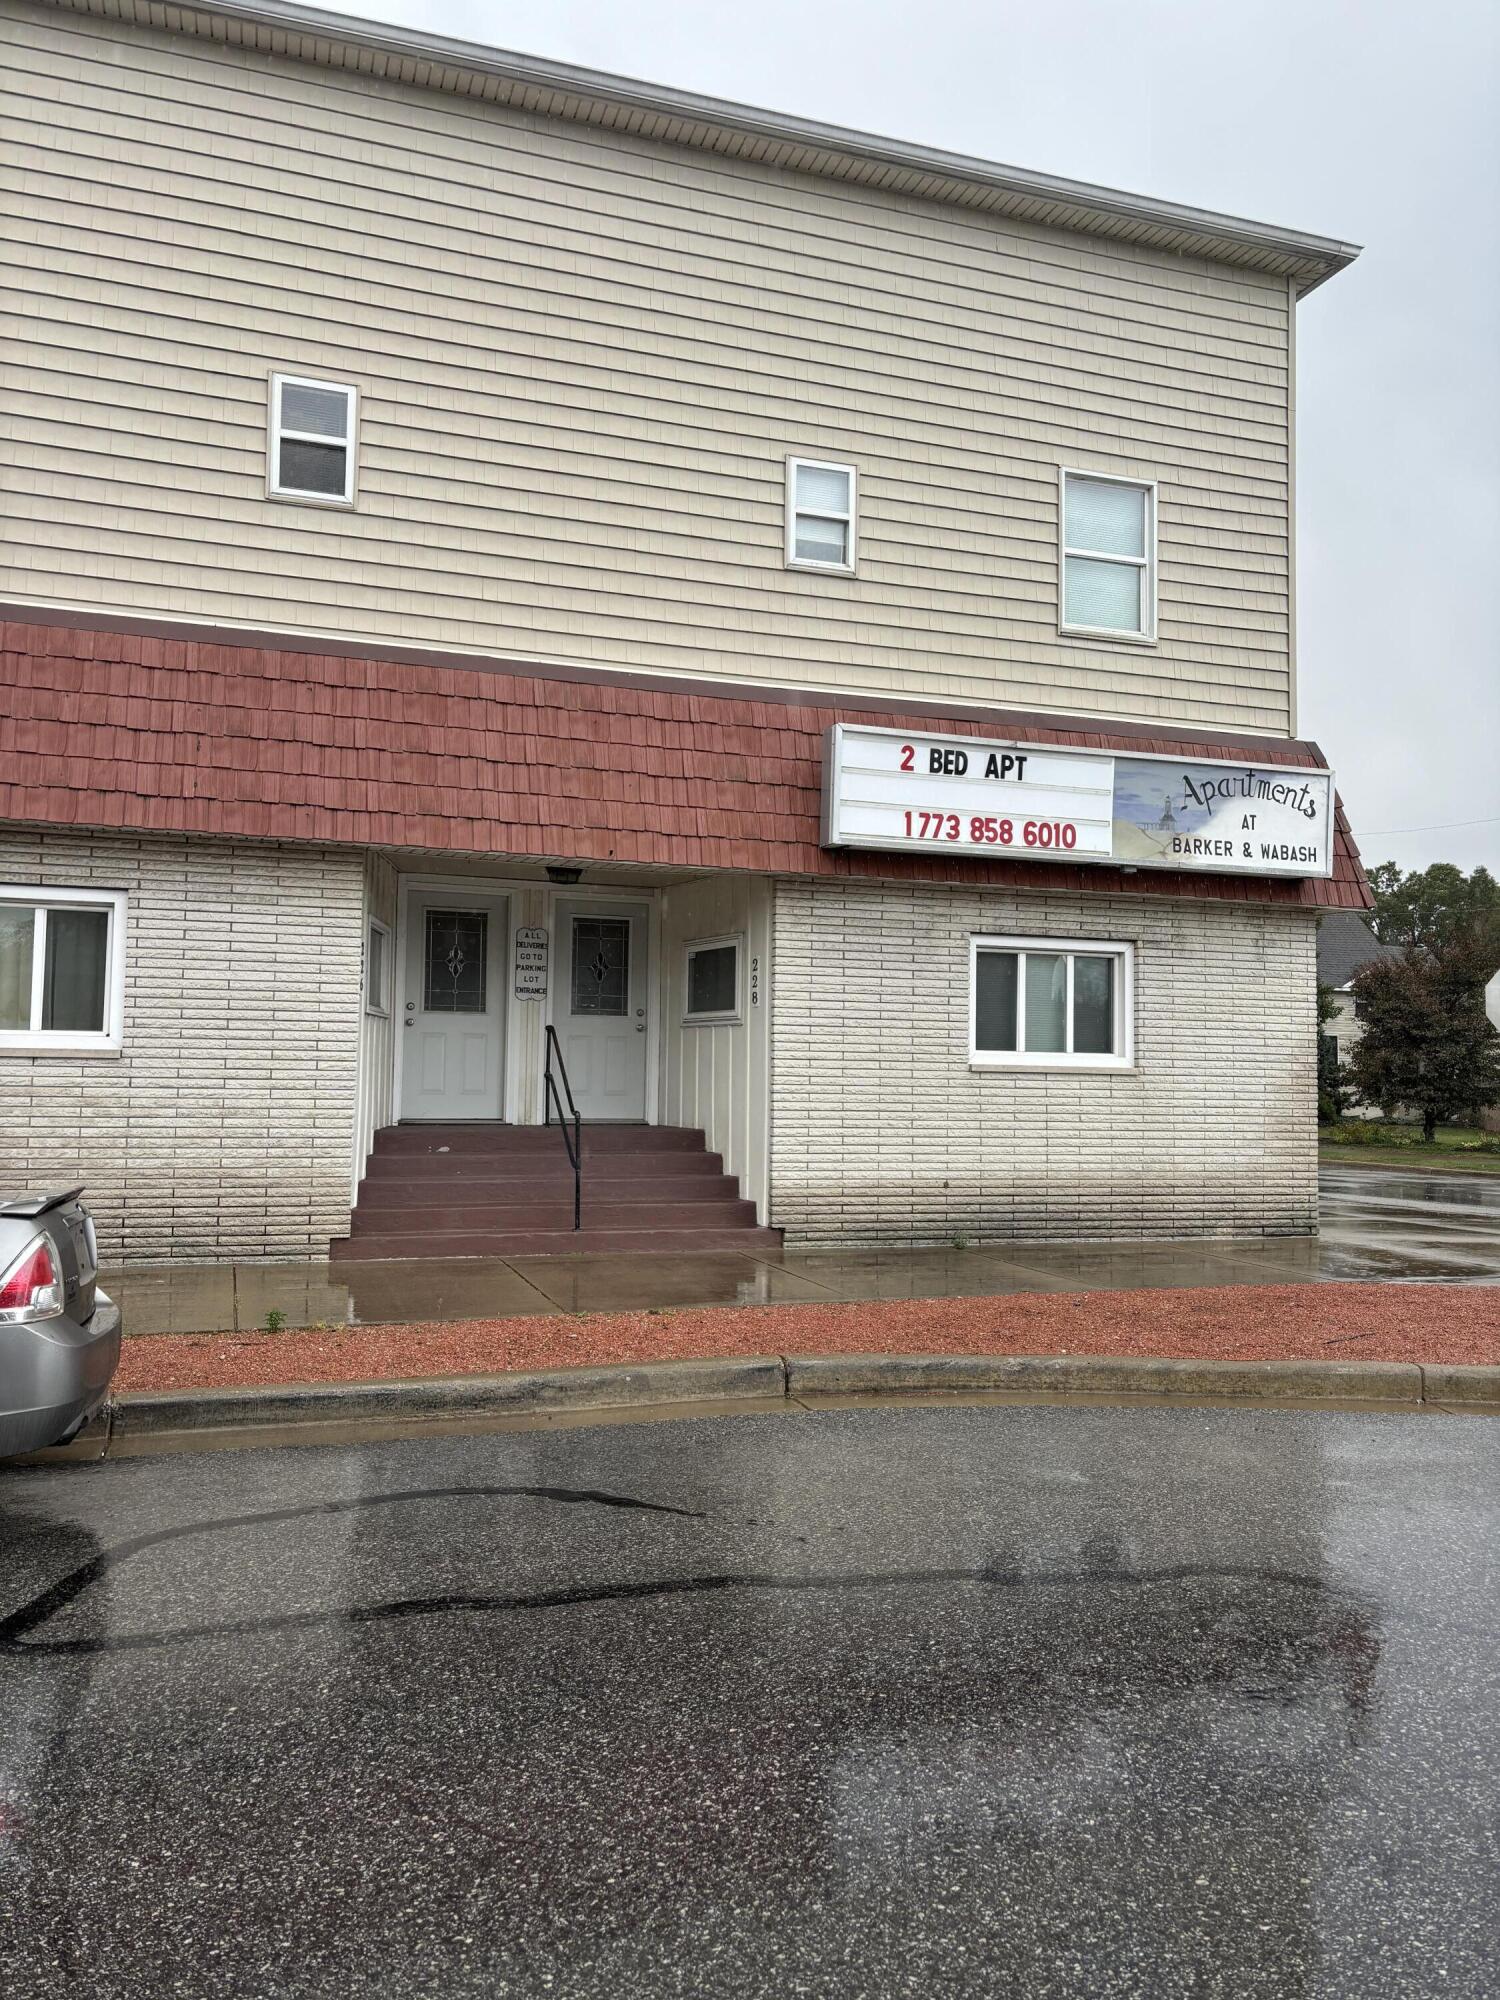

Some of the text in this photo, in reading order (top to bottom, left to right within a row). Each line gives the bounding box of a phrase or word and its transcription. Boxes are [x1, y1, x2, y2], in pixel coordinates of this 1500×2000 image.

[900, 745, 1027, 781] 2 BED APT
[1181, 769, 1317, 818] Apartments
[970, 816, 1013, 845] 858
[1023, 821, 1077, 849] 6010
[1241, 814, 1257, 830] AT
[1172, 837, 1318, 863] BARKER & WABASH
[524, 932, 542, 940] ALL
[516, 964, 547, 972] PARKING
[515, 986, 548, 995] ENTRANCE
